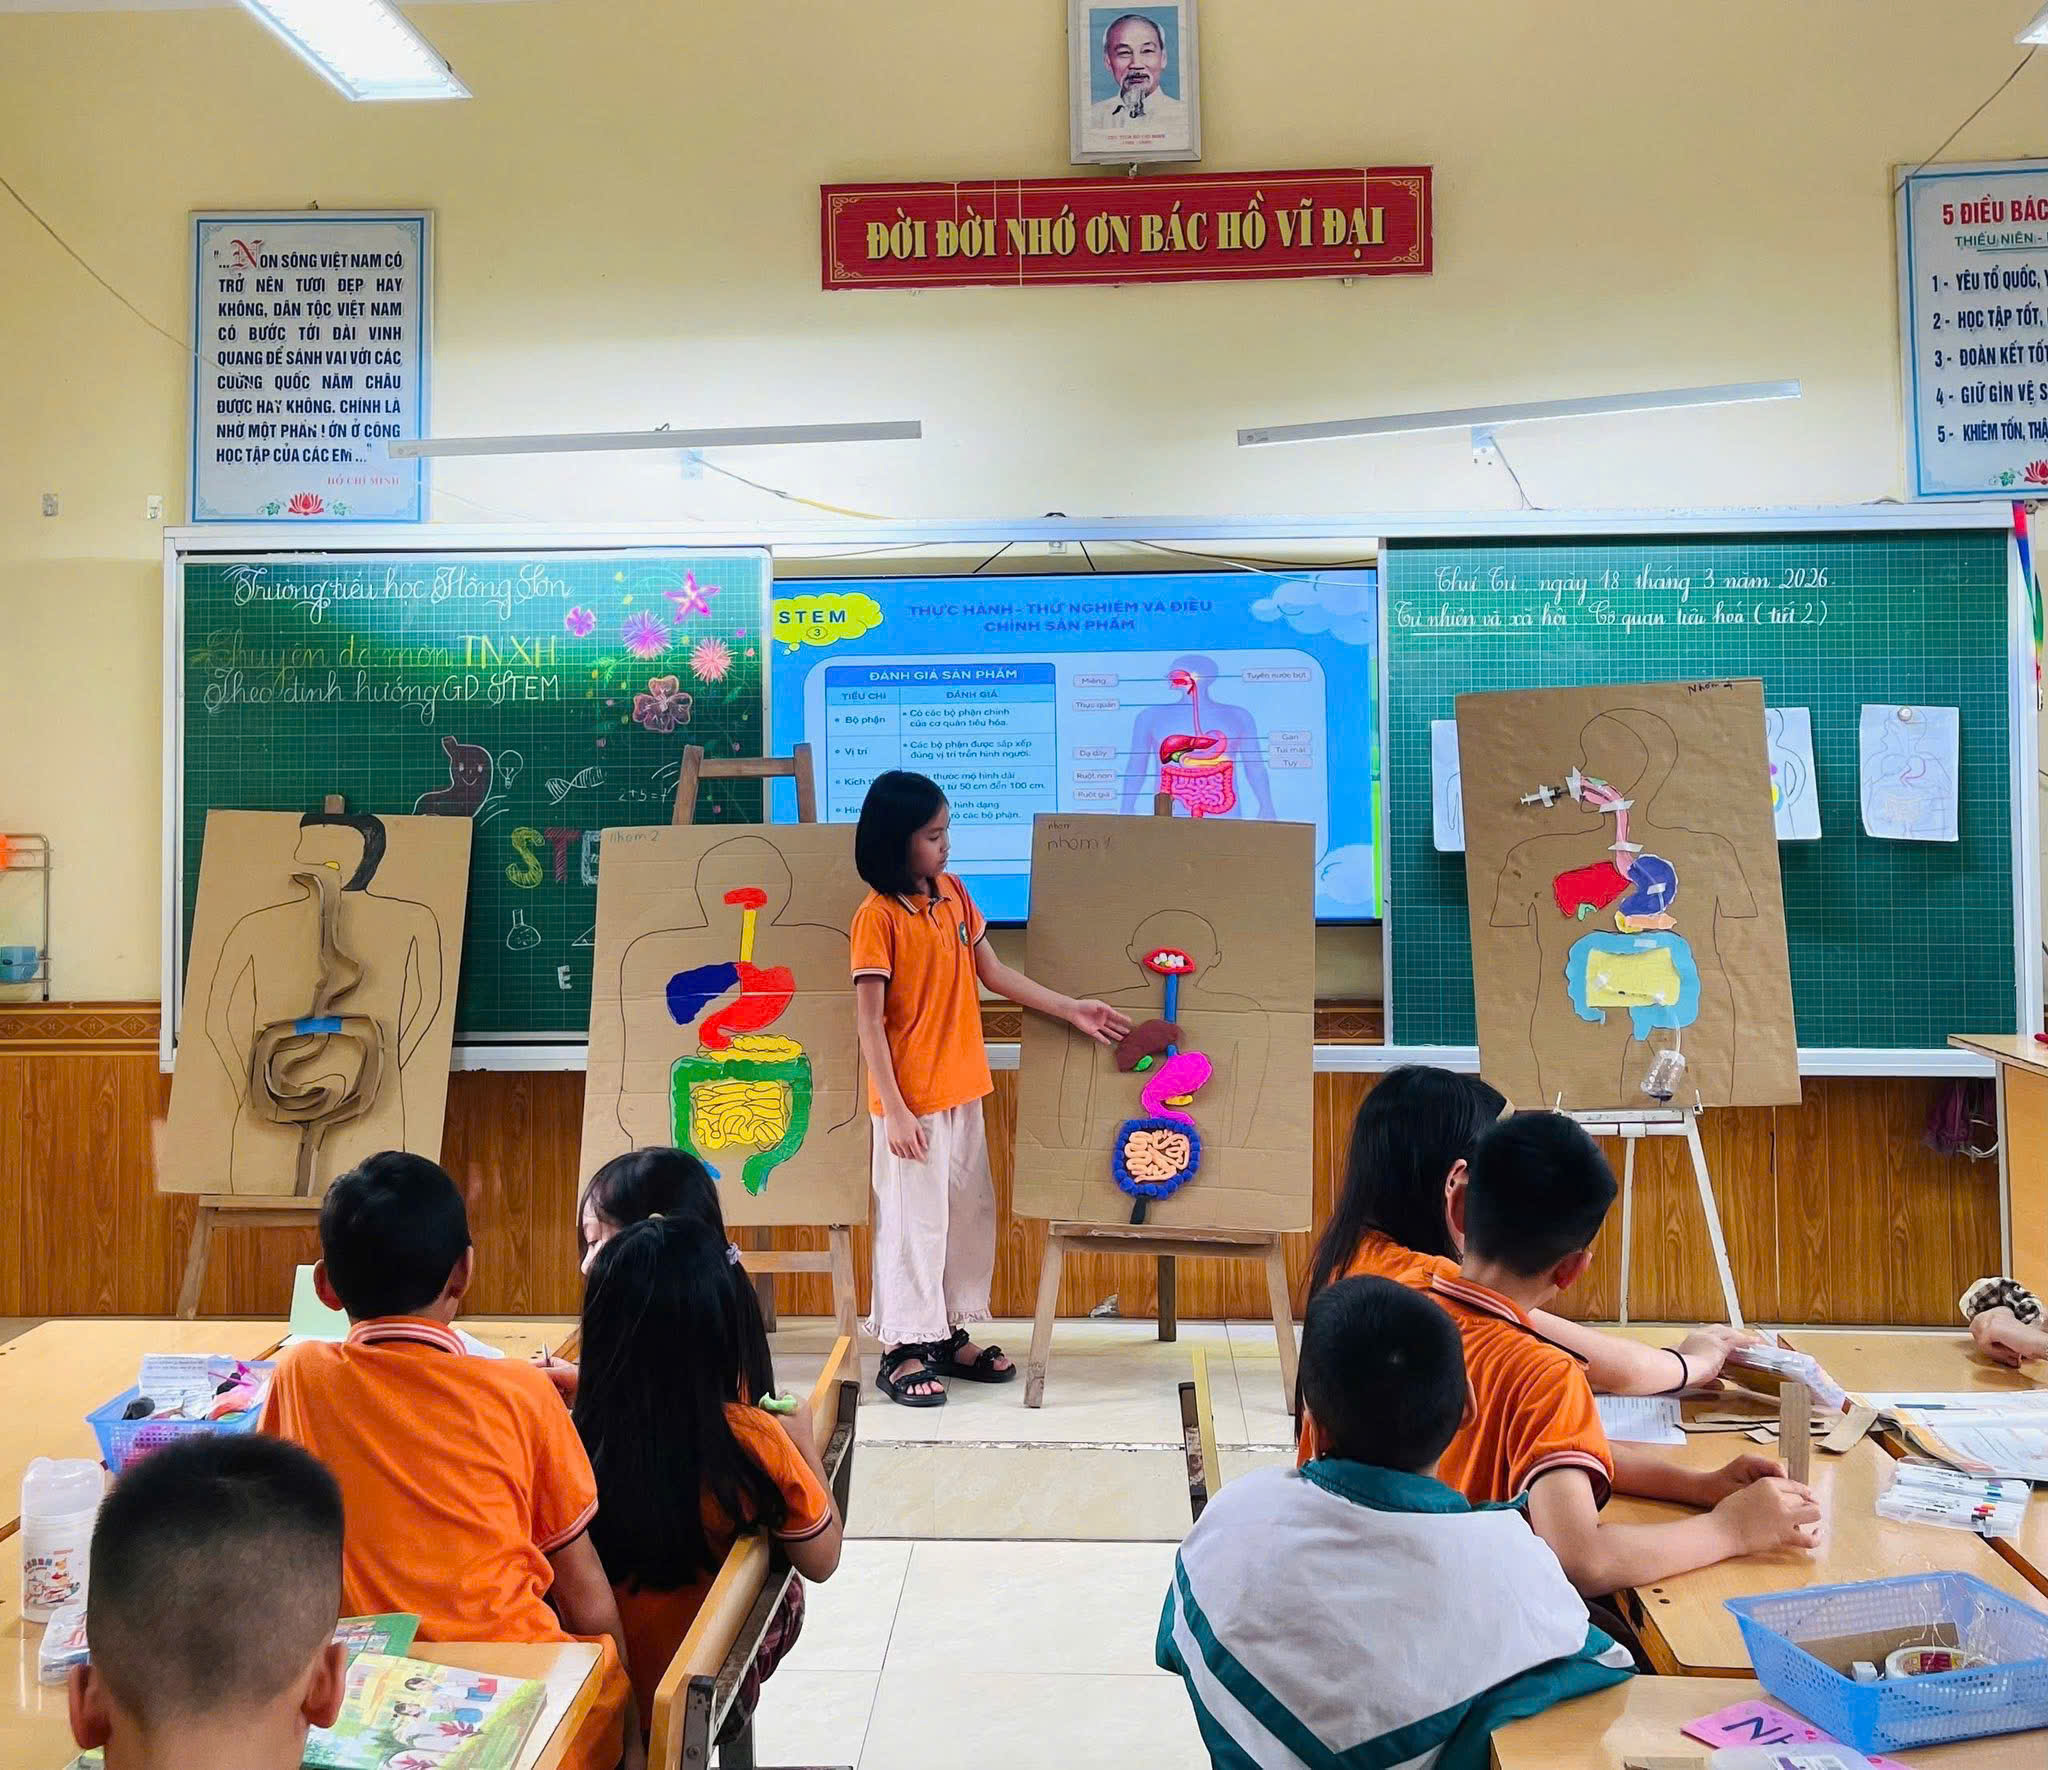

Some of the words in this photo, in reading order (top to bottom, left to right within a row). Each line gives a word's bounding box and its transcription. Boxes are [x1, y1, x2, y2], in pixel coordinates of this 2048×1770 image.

[1942, 204, 1954, 225] 5
[1960, 194, 2004, 225] ĐIỀU
[2011, 195, 2048, 222] BÁC
[866, 207, 928, 260] ĐỜI
[935, 204, 997, 258] ĐỜI
[1005, 203, 1076, 256] NHỚ
[1085, 211, 1132, 255] ƠN
[1139, 200, 1208, 252] BÁC
[1216, 190, 1266, 249] HỒ
[1274, 197, 1313, 247] VĨ
[1322, 207, 1385, 259] ĐẠI
[1955, 231, 1996, 247] THIẾU
[2001, 231, 2033, 245] NIÊN
[281, 251, 317, 268] SÔNG
[320, 251, 348, 271] VIỆT
[350, 253, 381, 268] NAM
[385, 250, 402, 268] CÓ
[219, 273, 245, 292] TRỞ
[256, 275, 284, 292] NÊN
[296, 278, 325, 292] TƯƠI
[337, 278, 364, 295] ĐẸP
[376, 278, 402, 292] HAY
[1956, 269, 1980, 291] YÊU
[1984, 264, 1999, 290] TỔ
[2002, 264, 2040, 290] QUỐC,
[218, 300, 268, 318] KHÔNG,
[273, 300, 301, 316] DÂN
[307, 300, 332, 319] TỘC
[337, 300, 366, 319] VIỆT
[370, 302, 402, 316] NAM
[1958, 310, 1984, 332] HỌC
[1988, 305, 2012, 331] TẬP
[2016, 301, 2043, 327] TỐT,
[218, 323, 236, 340] CÓ
[249, 323, 286, 341] BƯỚC
[298, 323, 320, 341] TỚI
[333, 323, 356, 341] ĐÀI
[369, 327, 402, 341] VINH
[217, 350, 263, 366] QUANG
[266, 345, 284, 365] ĐỂ
[286, 347, 322, 365] SÁNH
[325, 350, 347, 365] VAI
[350, 347, 371, 365] VỚI
[374, 347, 402, 365] CÁC
[1959, 344, 1996, 366] ĐOÀN
[2000, 340, 2024, 365] KẾT
[274, 370, 311, 391] QUỐC
[322, 372, 353, 389] NĂM
[365, 372, 402, 389] CHÂU
[1961, 381, 1986, 404] GIỮ
[1989, 380, 2013, 403] GÌN
[2018, 380, 2034, 405] VỆ
[217, 399, 252, 417] ĐƯỢC
[256, 399, 282, 414] HAY
[286, 397, 336, 414] KHÔNG.
[339, 398, 381, 414] CHÍNH
[385, 397, 401, 414] LÀ
[216, 420, 245, 438] NHỜ
[248, 421, 277, 441] MỘT
[351, 417, 361, 438] Ở
[364, 421, 401, 438] CÔNG
[1963, 419, 1998, 442] KHIÊM
[2000, 416, 2025, 441] TỐN,
[216, 448, 243, 465] HỌC
[246, 446, 270, 465] TẬP
[273, 442, 300, 462] CỦA
[302, 445, 330, 462] CÁC
[332, 448, 352, 462] EM
[220, 564, 331, 624] Trường
[383, 566, 425, 606] học
[430, 565, 512, 621] Hồng
[1435, 565, 1481, 592] Thứ
[1540, 571, 1588, 606] ngày
[1600, 567, 1620, 589] 18
[1635, 563, 1691, 602] tháng
[1703, 567, 1715, 589] 3
[1723, 571, 1771, 589] năm
[778, 609, 846, 624] STEM
[962, 602, 1012, 616] HÀNH
[1427, 602, 1476, 627] nhiên
[1482, 610, 1502, 626] và
[1509, 608, 1533, 626] xã
[1621, 612, 1667, 635] quan
[1677, 608, 1706, 625] tiêu
[814, 628, 821, 637] 3
[456, 634, 557, 669] TNXH
[869, 670, 910, 681] ĐÁNH
[914, 669, 939, 681] GIÁ
[442, 674, 480, 702] GD
[487, 669, 560, 709] STEM
[960, 782, 972, 790] 50
[557, 964, 573, 990] E
